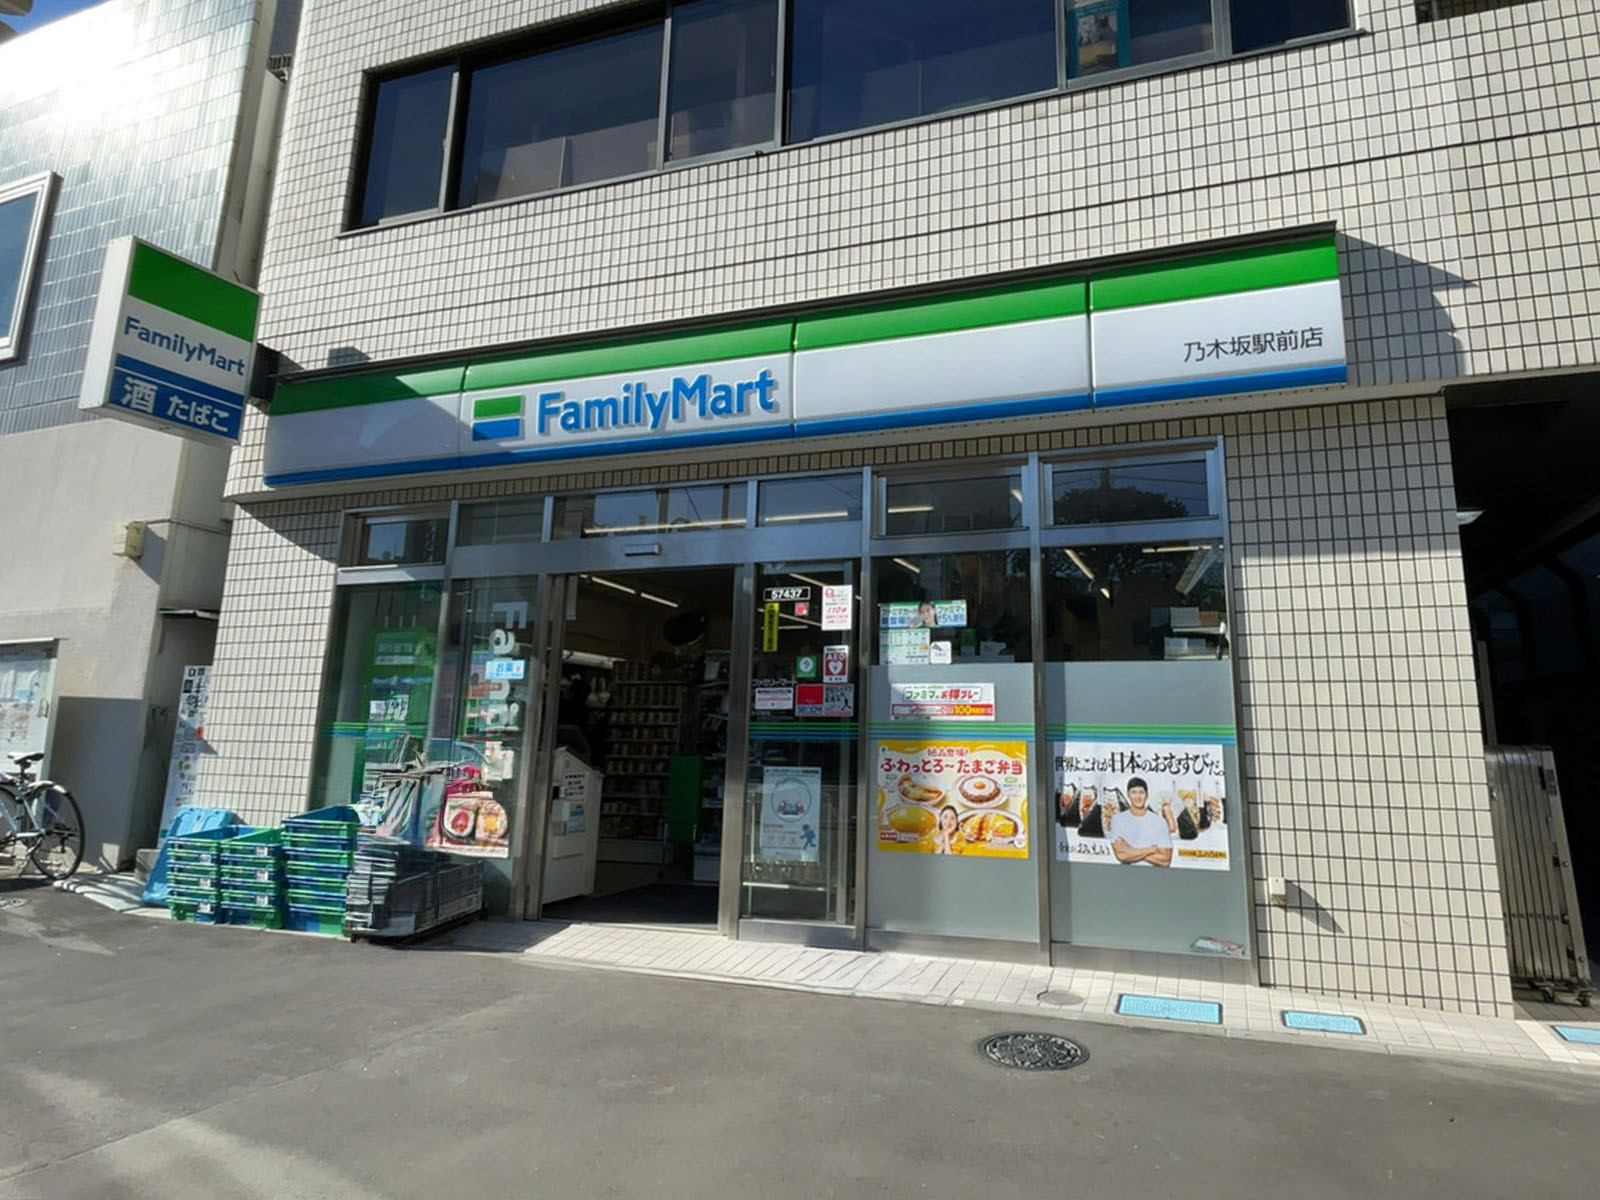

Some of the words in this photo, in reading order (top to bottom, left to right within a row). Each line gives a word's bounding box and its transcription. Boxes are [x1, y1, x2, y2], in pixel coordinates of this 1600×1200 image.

[124, 315, 246, 376] FamilyMart
[1184, 327, 1323, 362] 乃木坂駅前店
[120, 377, 158, 414] 酒
[167, 395, 230, 432] たばこ
[537, 368, 775, 434] FamilyMart
[771, 588, 803, 599] 57437
